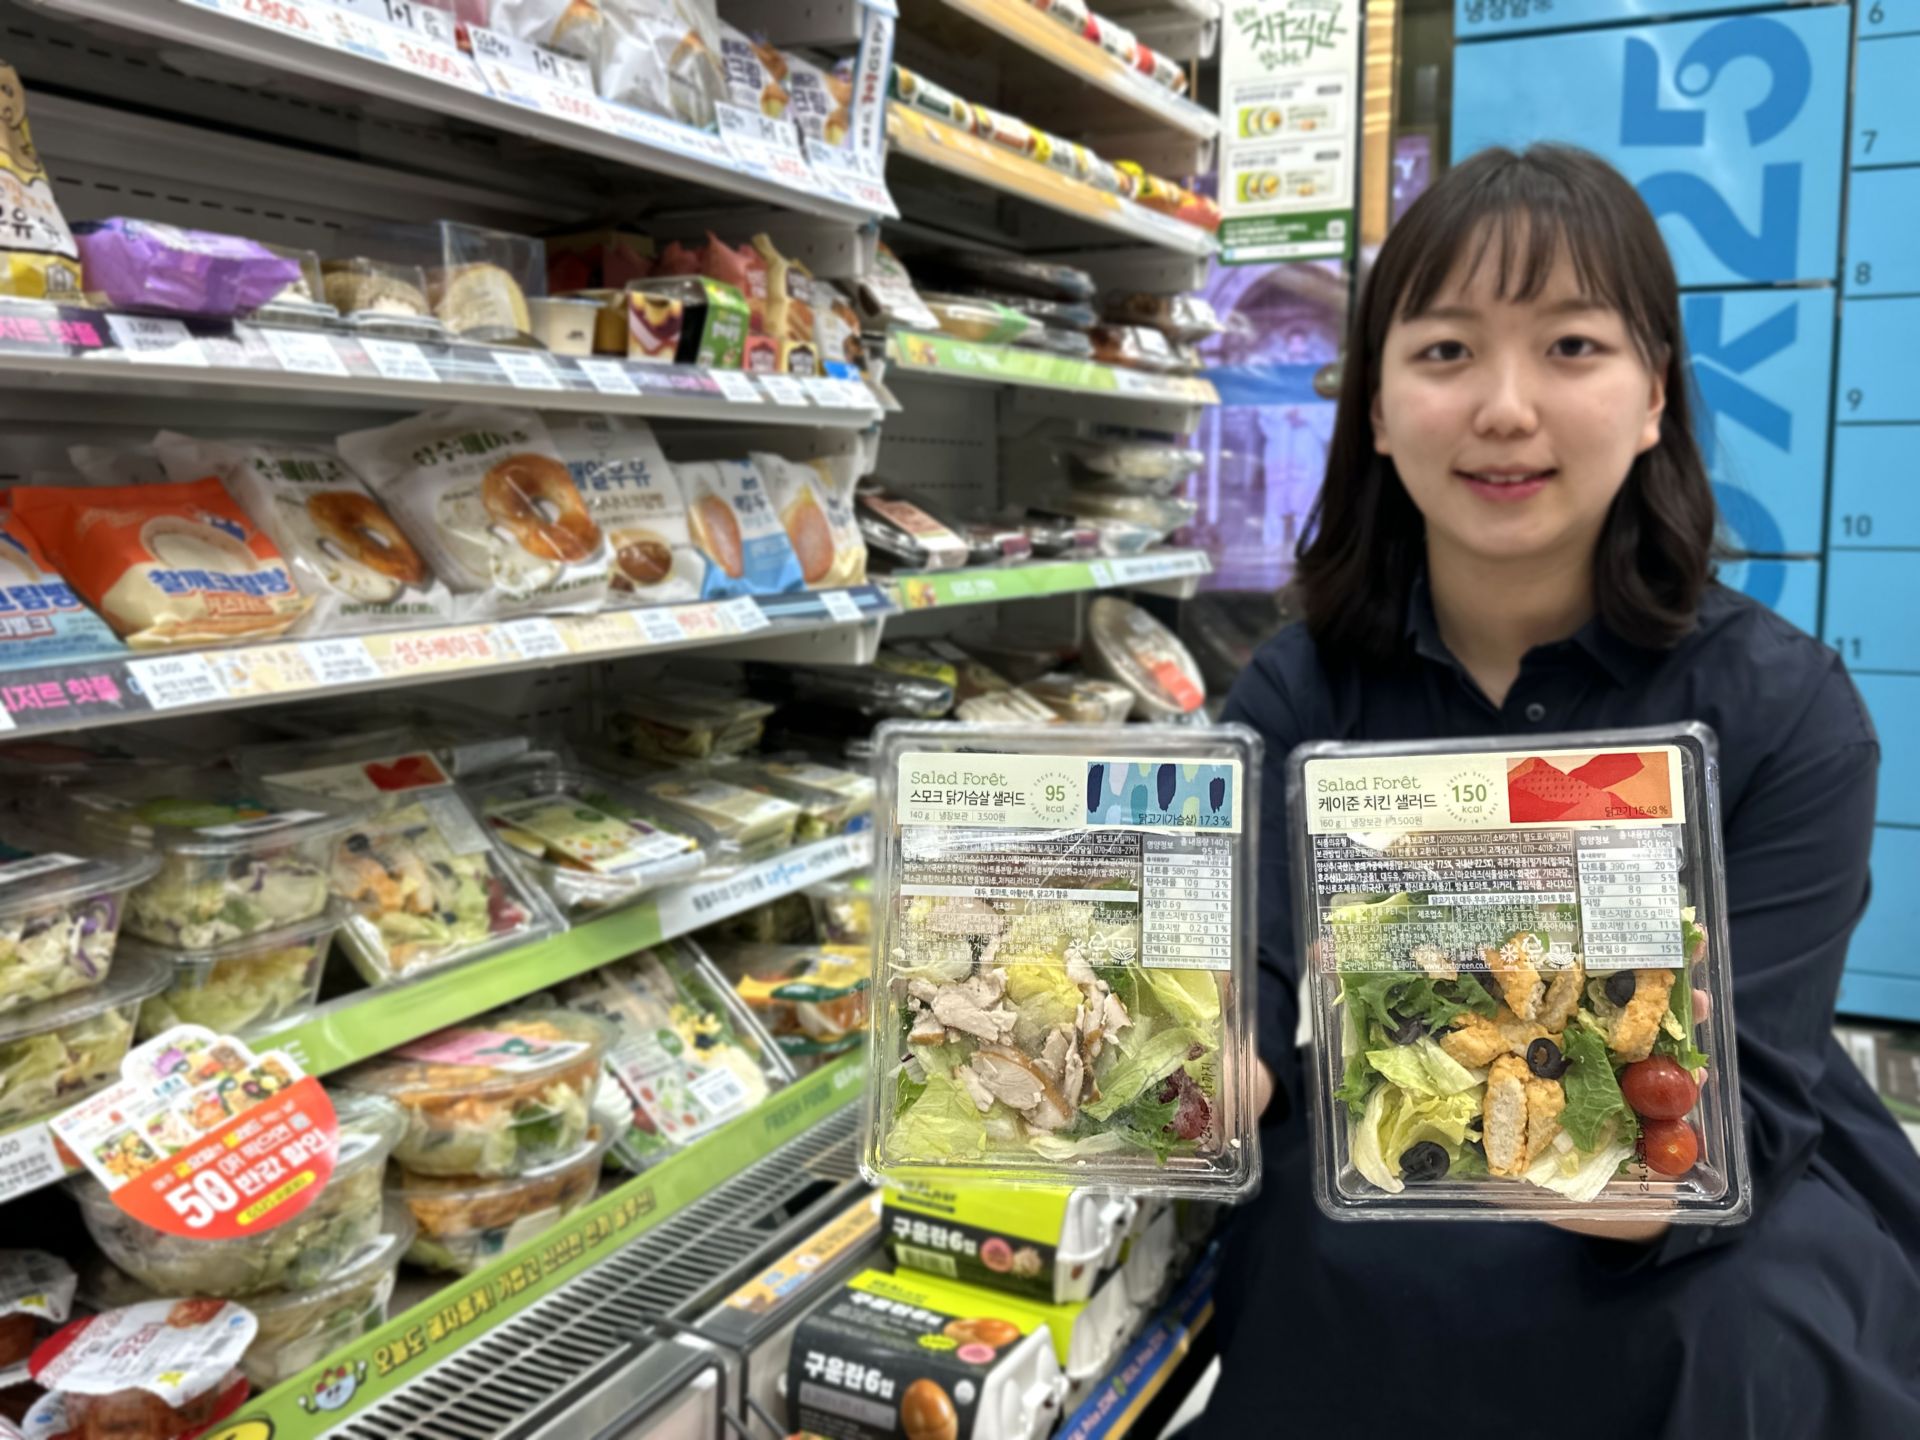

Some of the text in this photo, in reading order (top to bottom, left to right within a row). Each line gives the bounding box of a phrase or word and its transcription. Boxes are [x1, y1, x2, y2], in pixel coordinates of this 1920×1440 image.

[384, 0, 414, 28] 1+1
[1868, 1, 1884, 24] 6
[1860, 130, 1878, 153] 7
[1854, 263, 1870, 285] 8
[1848, 389, 1862, 410] 9
[1843, 515, 1872, 537] 10
[1835, 638, 1862, 659] 11
[911, 771, 1008, 787] Salad Forêt
[1317, 776, 1422, 792] Salad Forêt
[910, 789, 1026, 806] 스모크 닭가슴살 샐러드
[1045, 785, 1065, 802] 95
[1451, 784, 1488, 803] 150
[1046, 804, 1064, 813] kcal
[1318, 793, 1438, 813] 케이준 치킨 샐러드
[1462, 805, 1482, 813] kcal
[1604, 806, 1632, 818] 닭고기
[1659, 805, 1668, 815] %
[910, 810, 923, 819] 140
[939, 811, 968, 821] 냉장보관
[1138, 813, 1230, 827] 닭고기(가슴살) 17.3 %
[1351, 817, 1382, 827] 냉장보관
[1069, 834, 1092, 843] 소비기한
[1316, 832, 1568, 847] 식품의유형 소비기한 별도표시일까지
[1580, 830, 1650, 845] 영양정보 총 내용량
[1147, 837, 1223, 850] 영양정보 총 내용량 140
[1636, 839, 1674, 848] 150 kcal
[1201, 847, 1230, 856] 95 kcal
[1316, 850, 1341, 859] 보관방법
[1488, 845, 1520, 855] 고객상담실
[1146, 866, 1220, 878] 나트륨 580 mg 29
[1582, 861, 1666, 873] 나트륨 390 mg 20
[1146, 877, 1193, 887] 탄수화물 10
[1582, 874, 1633, 884] 탄수화물 16
[1037, 890, 1056, 899] 닭고기
[1150, 888, 1166, 897] 당류
[1211, 890, 1220, 898] 14
[1588, 886, 1605, 896] 당류
[1558, 894, 1572, 904] 함유
[1584, 897, 1667, 908] 지방 11
[1146, 900, 1174, 910] 지방 0.6
[1150, 911, 1225, 922] 트랜스지방 0.5 미만
[1417, 910, 1444, 920] 제조업소
[1590, 907, 1674, 918] 트랜스지방 0.5 미만
[1150, 923, 1202, 932] 포화지방 0.2
[1591, 920, 1624, 930] 포화지방
[1659, 920, 1668, 929] 11
[1210, 936, 1220, 945] 10
[1587, 932, 1638, 943] 콜레스테롤 20
[1146, 945, 1219, 956] 단백질 11
[1587, 945, 1672, 954] 단백질 15
[1423, 961, 1491, 971] www.justgreen.co.kr
[233, 1152, 288, 1198] 반값
[284, 1128, 329, 1168] 할인
[892, 1216, 977, 1257] 구운란6입
[374, 1327, 427, 1378] 오늘도
[804, 1350, 895, 1399] 구운란6입
